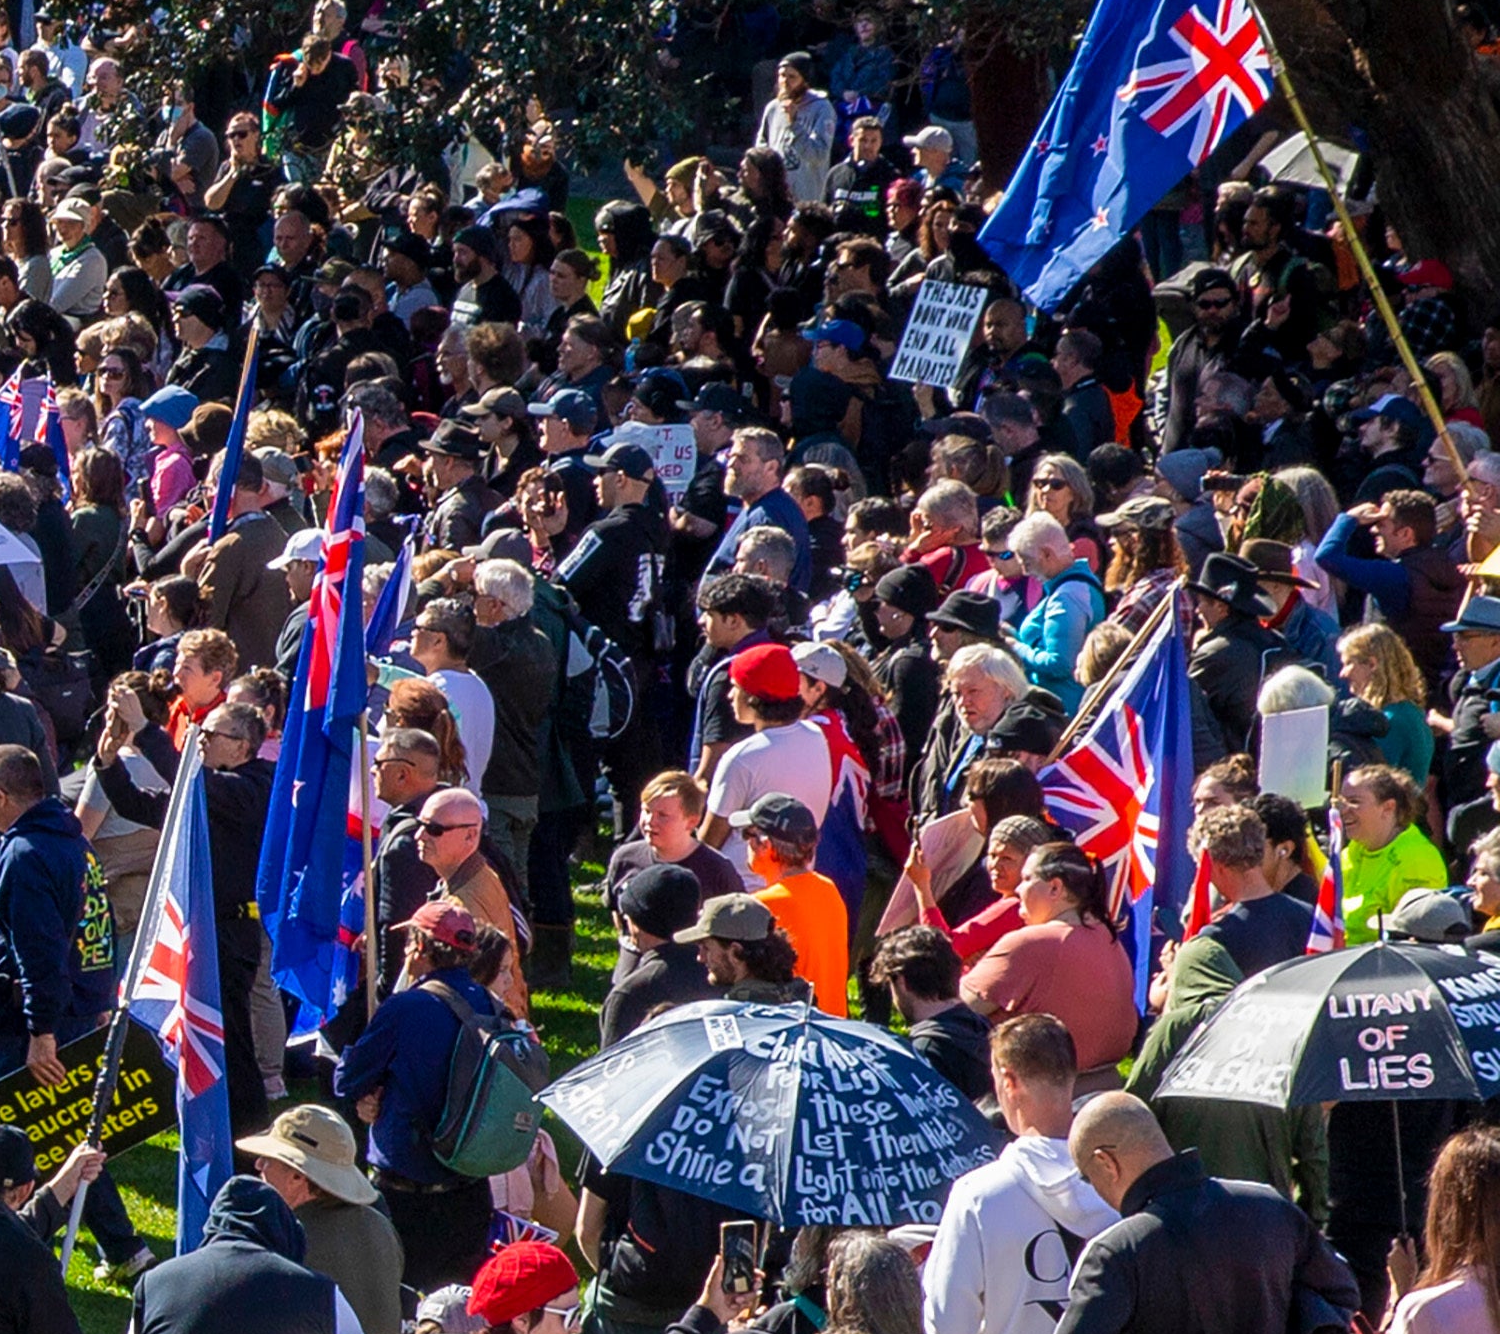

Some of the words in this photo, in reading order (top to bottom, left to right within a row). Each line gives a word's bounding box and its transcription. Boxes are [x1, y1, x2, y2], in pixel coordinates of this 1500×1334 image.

[924, 281, 947, 303] THE
[946, 283, 982, 309] JABS
[912, 304, 947, 327] DONT
[945, 308, 975, 333] WORK
[904, 328, 930, 351] END
[929, 335, 956, 357] ALL
[894, 352, 957, 385] MANDATES
[674, 445, 694, 460] US
[1328, 984, 1433, 1019] LITANY
[744, 1031, 820, 1068] Child
[1358, 1025, 1410, 1051] OF
[14, 1062, 94, 1114] layers
[122, 1068, 152, 1093] in
[1339, 1053, 1435, 1091] LIES
[690, 1072, 793, 1125] Expose
[809, 1092, 899, 1129] these
[671, 1104, 713, 1136] Do
[726, 1123, 787, 1155] Not
[802, 1118, 853, 1159] Let
[864, 1124, 928, 1161] them
[645, 1130, 734, 1185] Shine
[738, 1163, 767, 1193] a
[795, 1154, 859, 1203] Light
[861, 1163, 900, 1196] into
[900, 1158, 942, 1193] the
[796, 1197, 840, 1226] for
[841, 1190, 892, 1226] All
[900, 1192, 942, 1218] to
